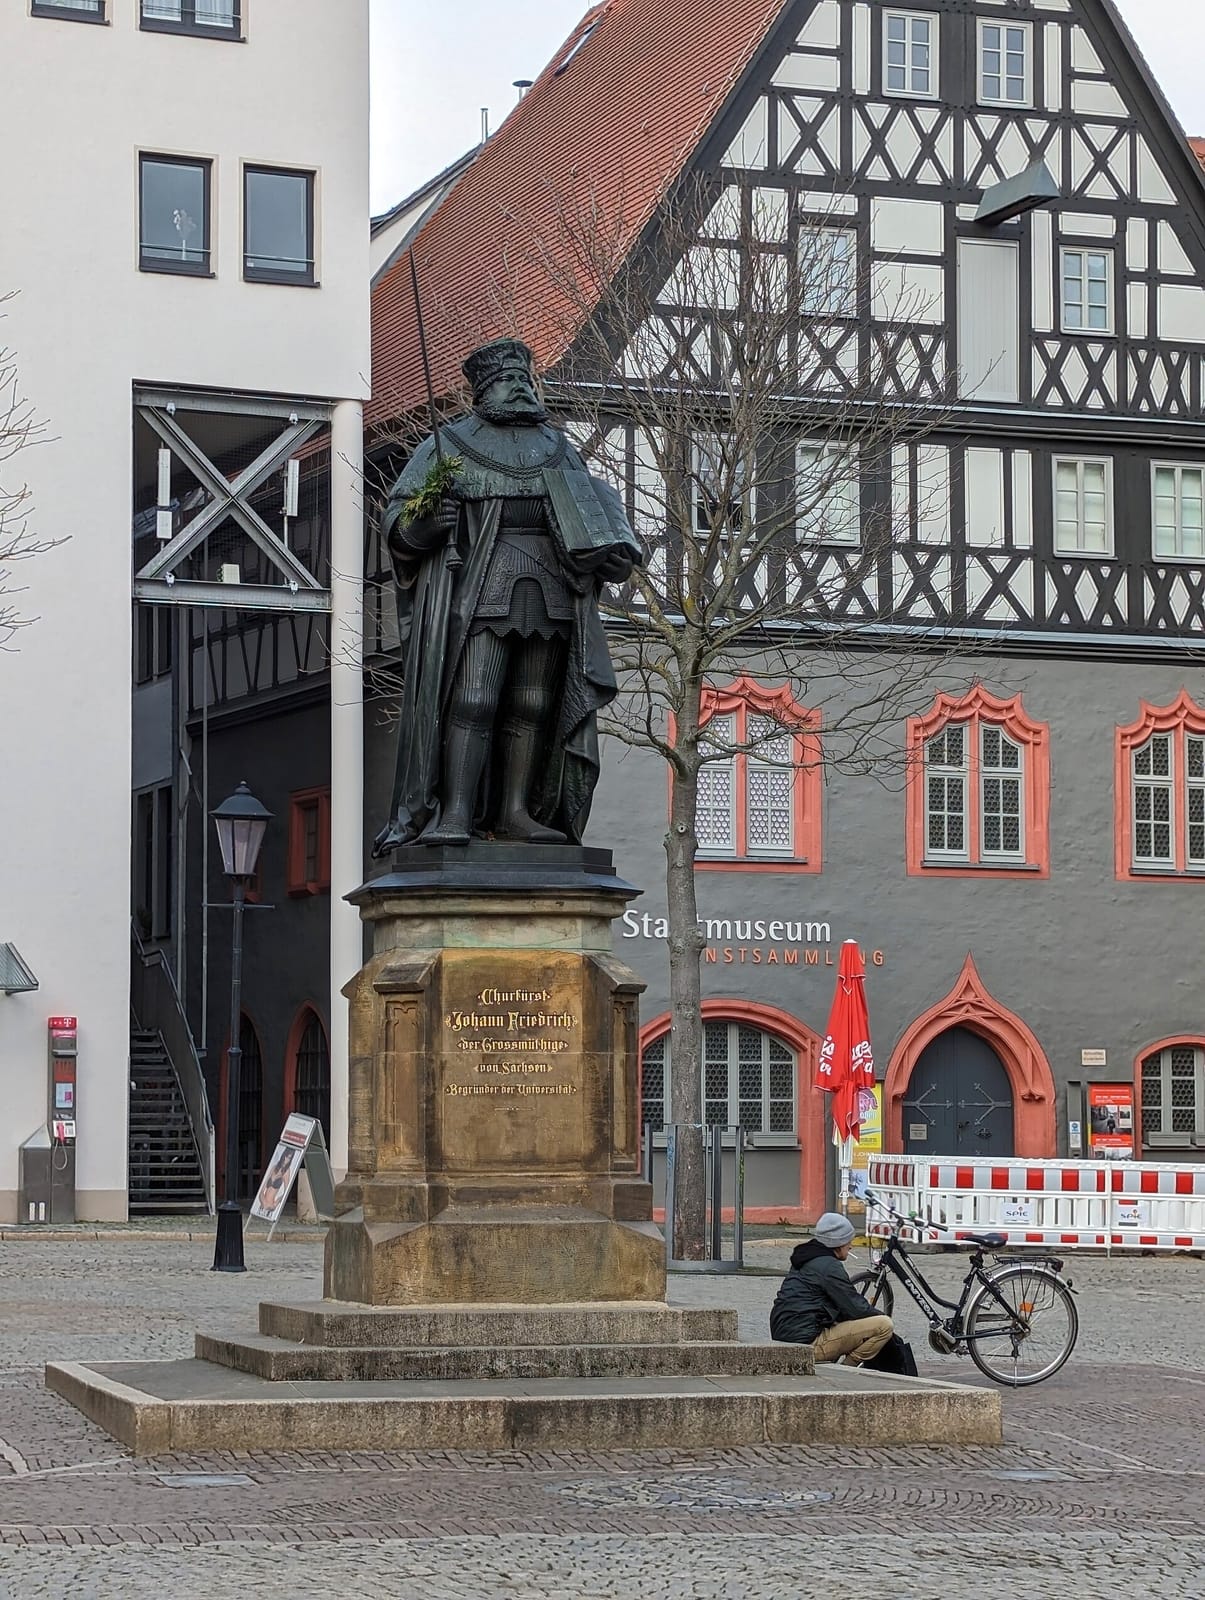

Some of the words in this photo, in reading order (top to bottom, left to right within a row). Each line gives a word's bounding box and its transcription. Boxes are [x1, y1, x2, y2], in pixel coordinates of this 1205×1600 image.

[622, 909, 832, 943] Stamuseum
[452, 1010, 504, 1031] Johann
[507, 1010, 572, 1031] Friedrich
[462, 1037, 481, 1052] der
[480, 1064, 499, 1073] von
[500, 1061, 547, 1075] Sachsen
[502, 1083, 516, 1095] der
